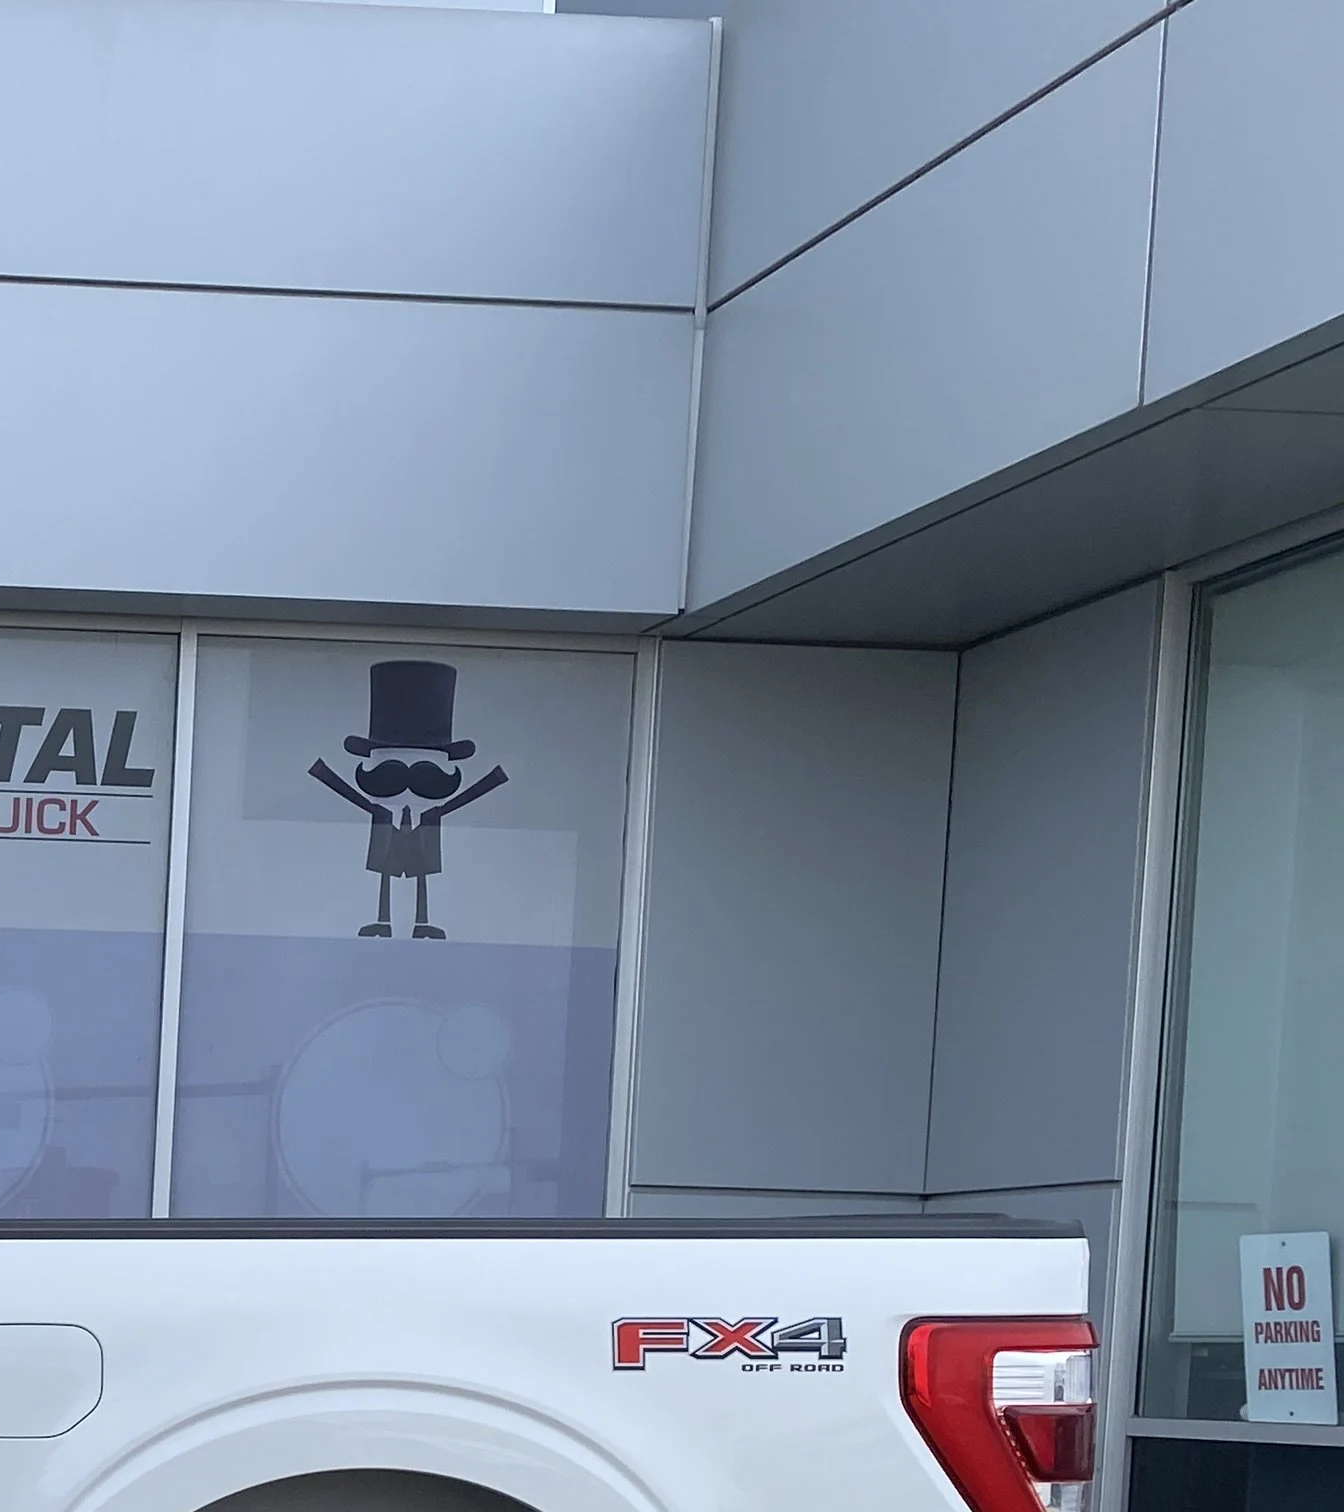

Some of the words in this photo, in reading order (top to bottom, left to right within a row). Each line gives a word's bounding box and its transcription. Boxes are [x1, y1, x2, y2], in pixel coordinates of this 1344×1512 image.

[1262, 1265, 1306, 1311] NO
[612, 1317, 847, 1371] FX4
[1254, 1320, 1321, 1344] PARKING
[741, 1363, 782, 1372] OFF
[790, 1363, 845, 1372] ROAD
[1258, 1367, 1325, 1391] ANYTIME
